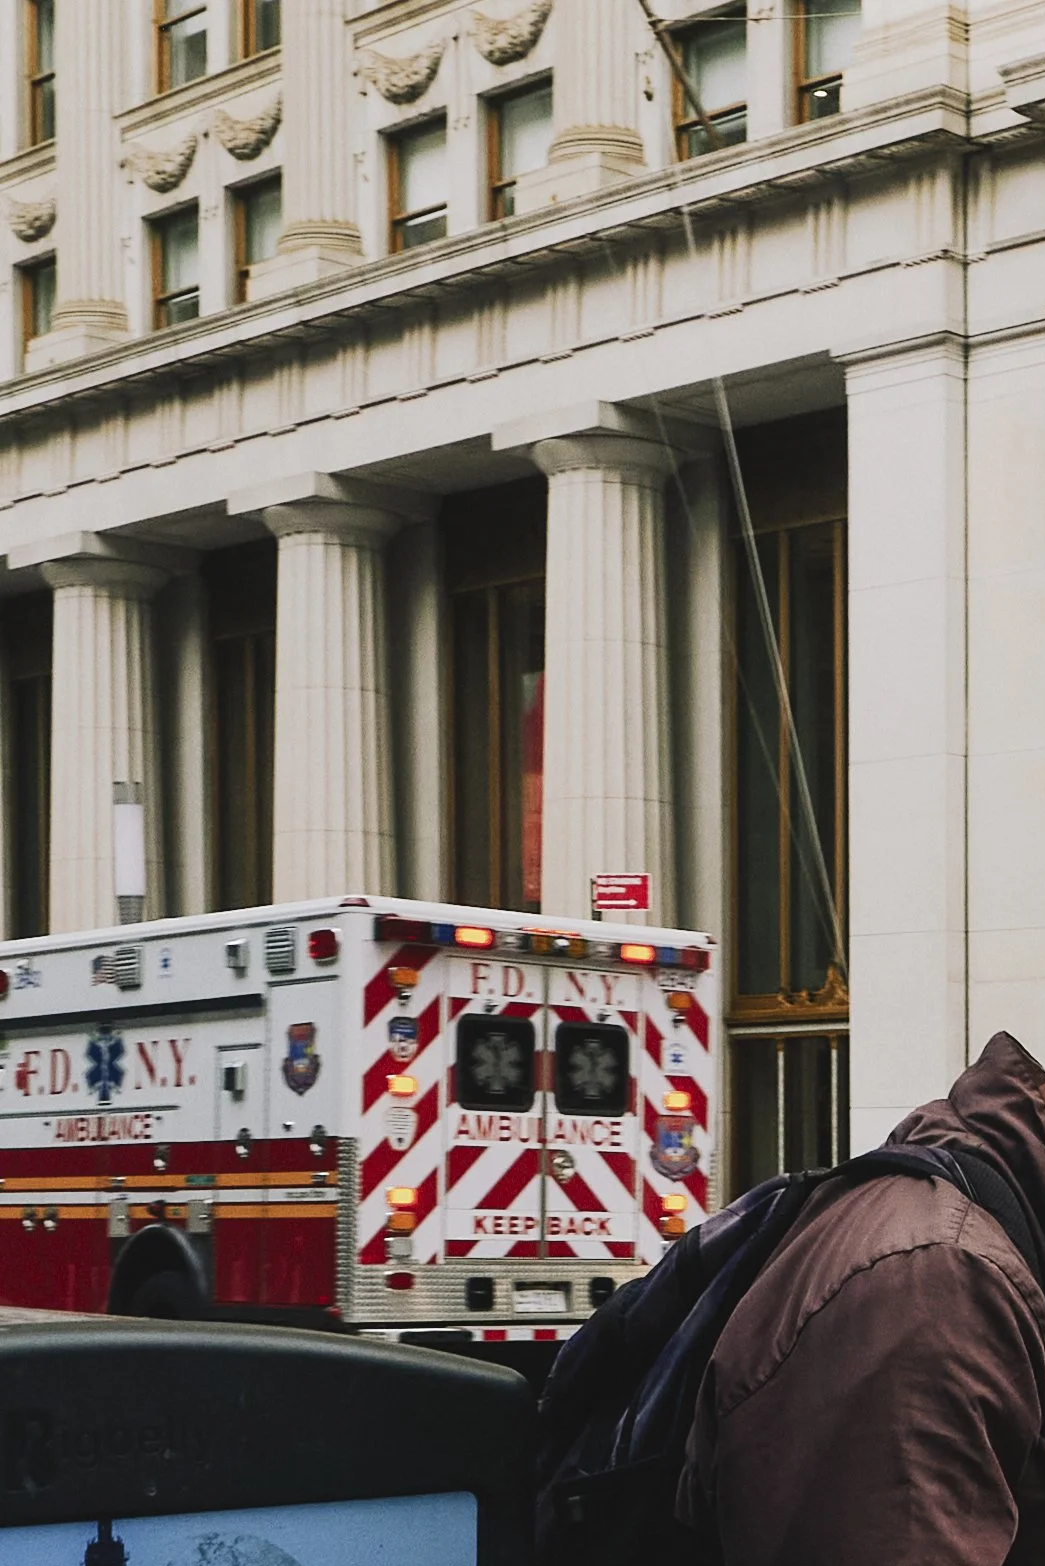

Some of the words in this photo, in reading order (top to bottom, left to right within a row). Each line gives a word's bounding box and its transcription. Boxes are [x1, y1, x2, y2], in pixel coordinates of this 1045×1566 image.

[470, 962, 534, 998] F.D.
[565, 971, 624, 1006] N.Y.
[23, 1048, 79, 1096] F.D.
[134, 1037, 196, 1090] N.Y.
[53, 1113, 152, 1143] AMBULANCE
[454, 1113, 622, 1147] AMBULANCE
[473, 1215, 535, 1235] KEEP
[548, 1216, 612, 1236] BACK
